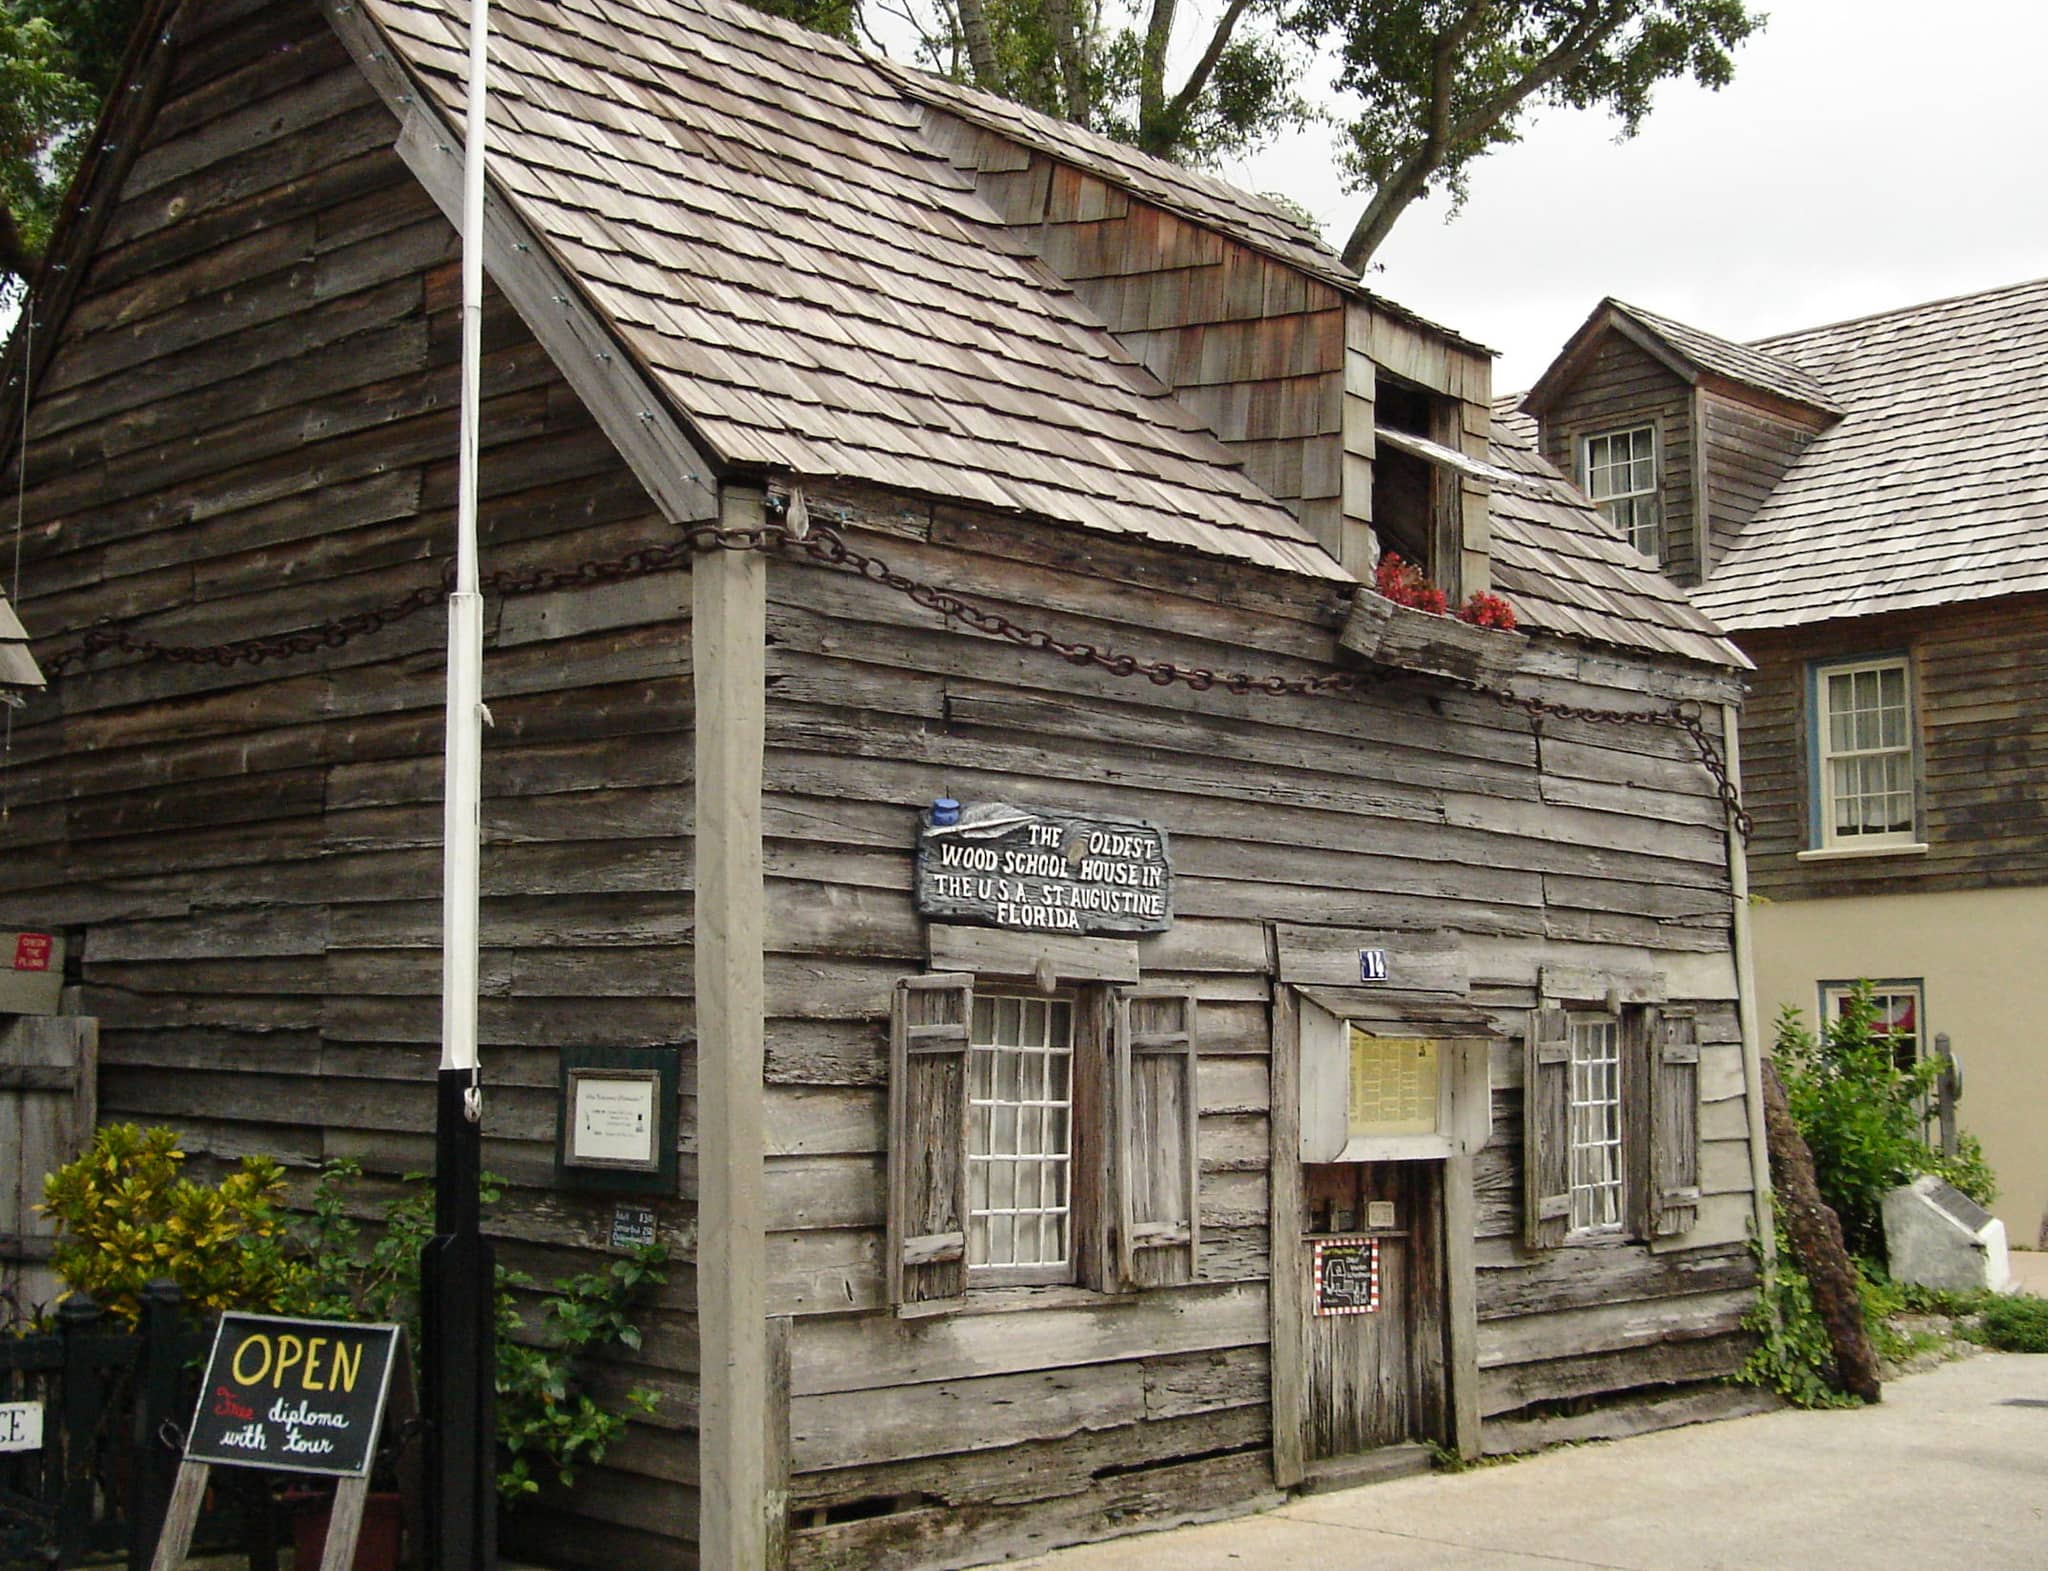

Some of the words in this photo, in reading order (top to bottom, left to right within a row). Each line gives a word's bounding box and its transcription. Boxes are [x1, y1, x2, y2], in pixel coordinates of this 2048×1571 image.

[1028, 825, 1063, 848] THE
[1089, 832, 1155, 859] OLDEST
[941, 844, 998, 872] WOOD
[1002, 851, 1068, 878] SCHOOL
[1080, 859, 1138, 886] HOUSE
[1141, 867, 1163, 888] IN
[934, 874, 972, 898] THE
[997, 902, 1080, 928] FLORIDA
[1367, 951, 1384, 977] 14
[232, 1334, 363, 1392] OPEN
[268, 1397, 349, 1431] diploma
[219, 1423, 267, 1450] with
[282, 1430, 333, 1454] tour
